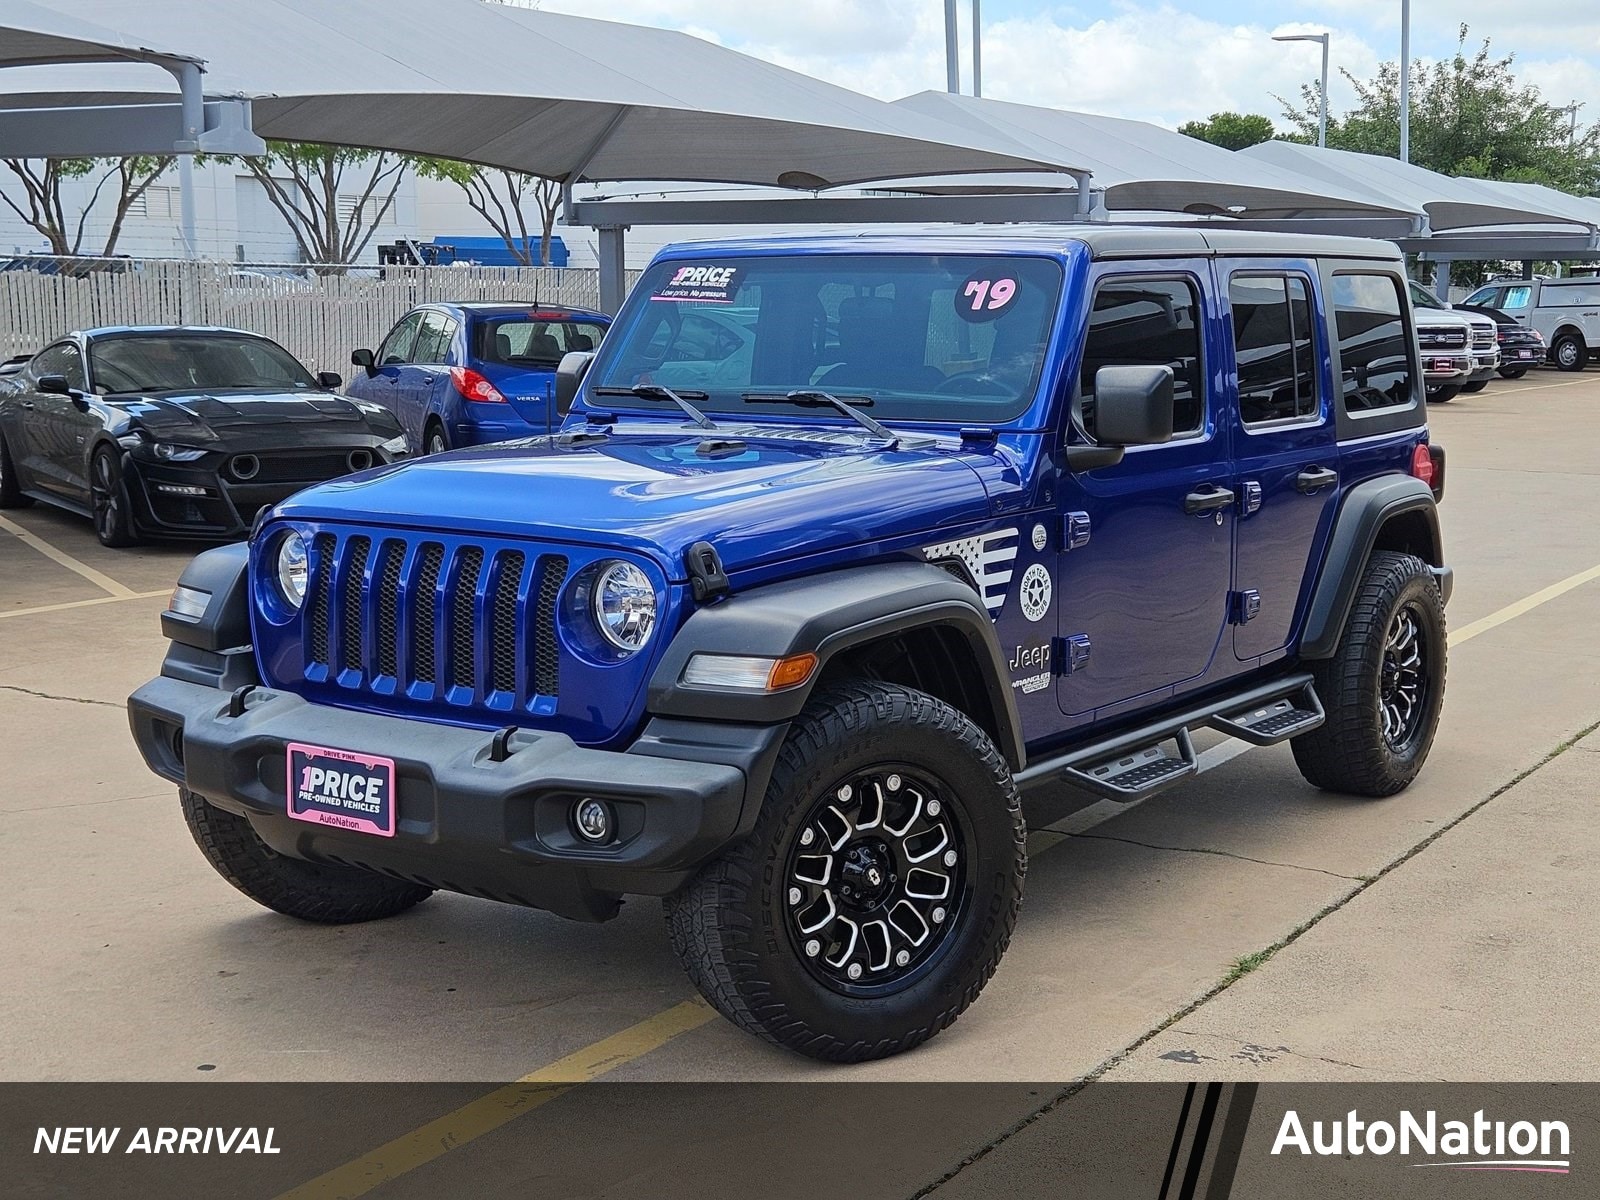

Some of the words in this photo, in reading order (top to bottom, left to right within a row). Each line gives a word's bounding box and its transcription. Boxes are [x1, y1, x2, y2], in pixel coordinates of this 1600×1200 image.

[672, 266, 736, 283] 1PRICE
[689, 289, 700, 297] No
[963, 278, 1016, 310] '19
[1022, 568, 1036, 594] NORTH
[1036, 567, 1050, 591] TEXAS
[1023, 602, 1036, 617] JEEP
[1035, 599, 1048, 617] CLUB
[1009, 644, 1050, 672] Jeep
[323, 750, 341, 759] DRIVE
[342, 753, 356, 761] PINK
[300, 766, 384, 805] 1PRICE
[298, 790, 341, 807] PRE-OWNED
[342, 799, 380, 813] VEHICLES
[319, 813, 360, 829] AutoNation
